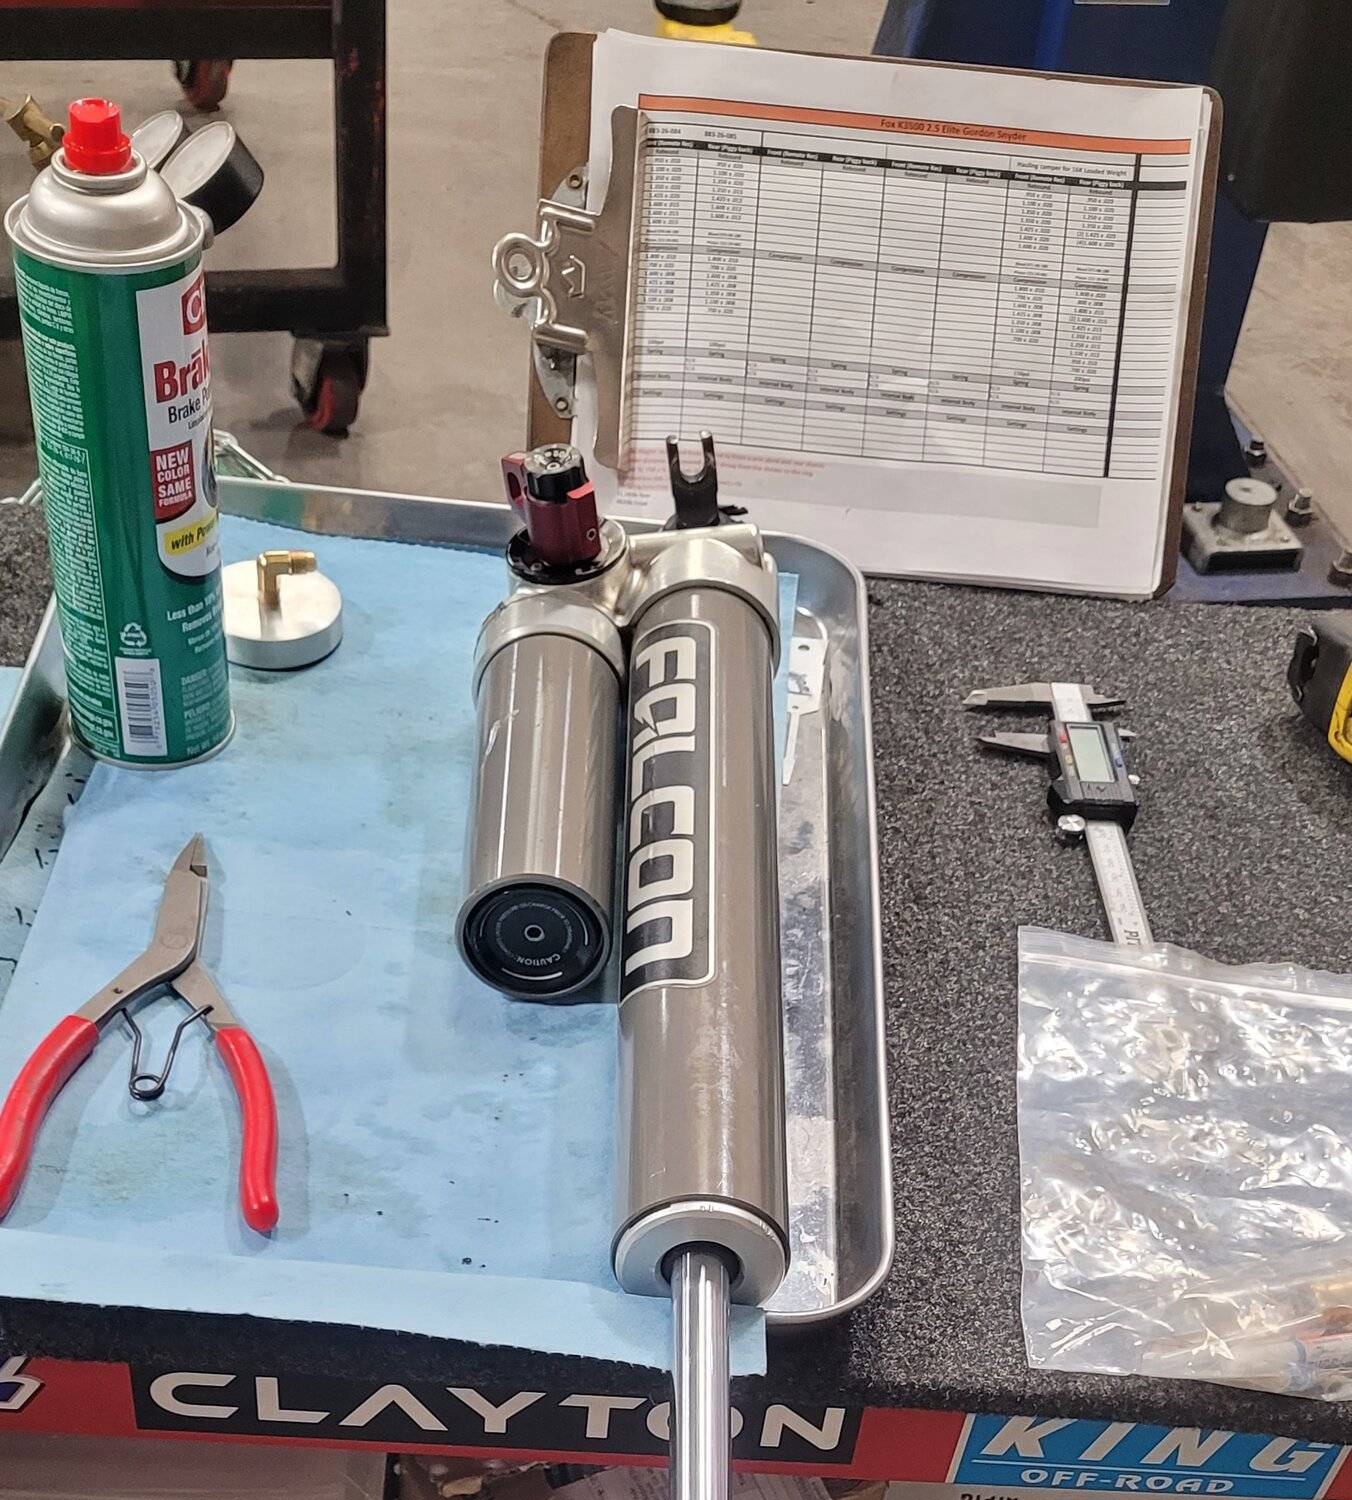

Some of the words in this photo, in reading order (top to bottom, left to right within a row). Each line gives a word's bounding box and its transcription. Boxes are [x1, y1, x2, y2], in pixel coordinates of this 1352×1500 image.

[880, 120, 895, 128] Fox
[962, 127, 995, 138] Gordon
[997, 130, 1027, 142] Snyder
[168, 395, 200, 424] Brake
[156, 447, 190, 471] NEW
[157, 463, 191, 483] COLOR
[158, 478, 192, 498] SAME
[171, 532, 194, 550] with
[625, 635, 698, 977] FALCON
[980, 1414, 1329, 1474] KING
[1020, 1468, 1235, 1494] OFF-ROAD
